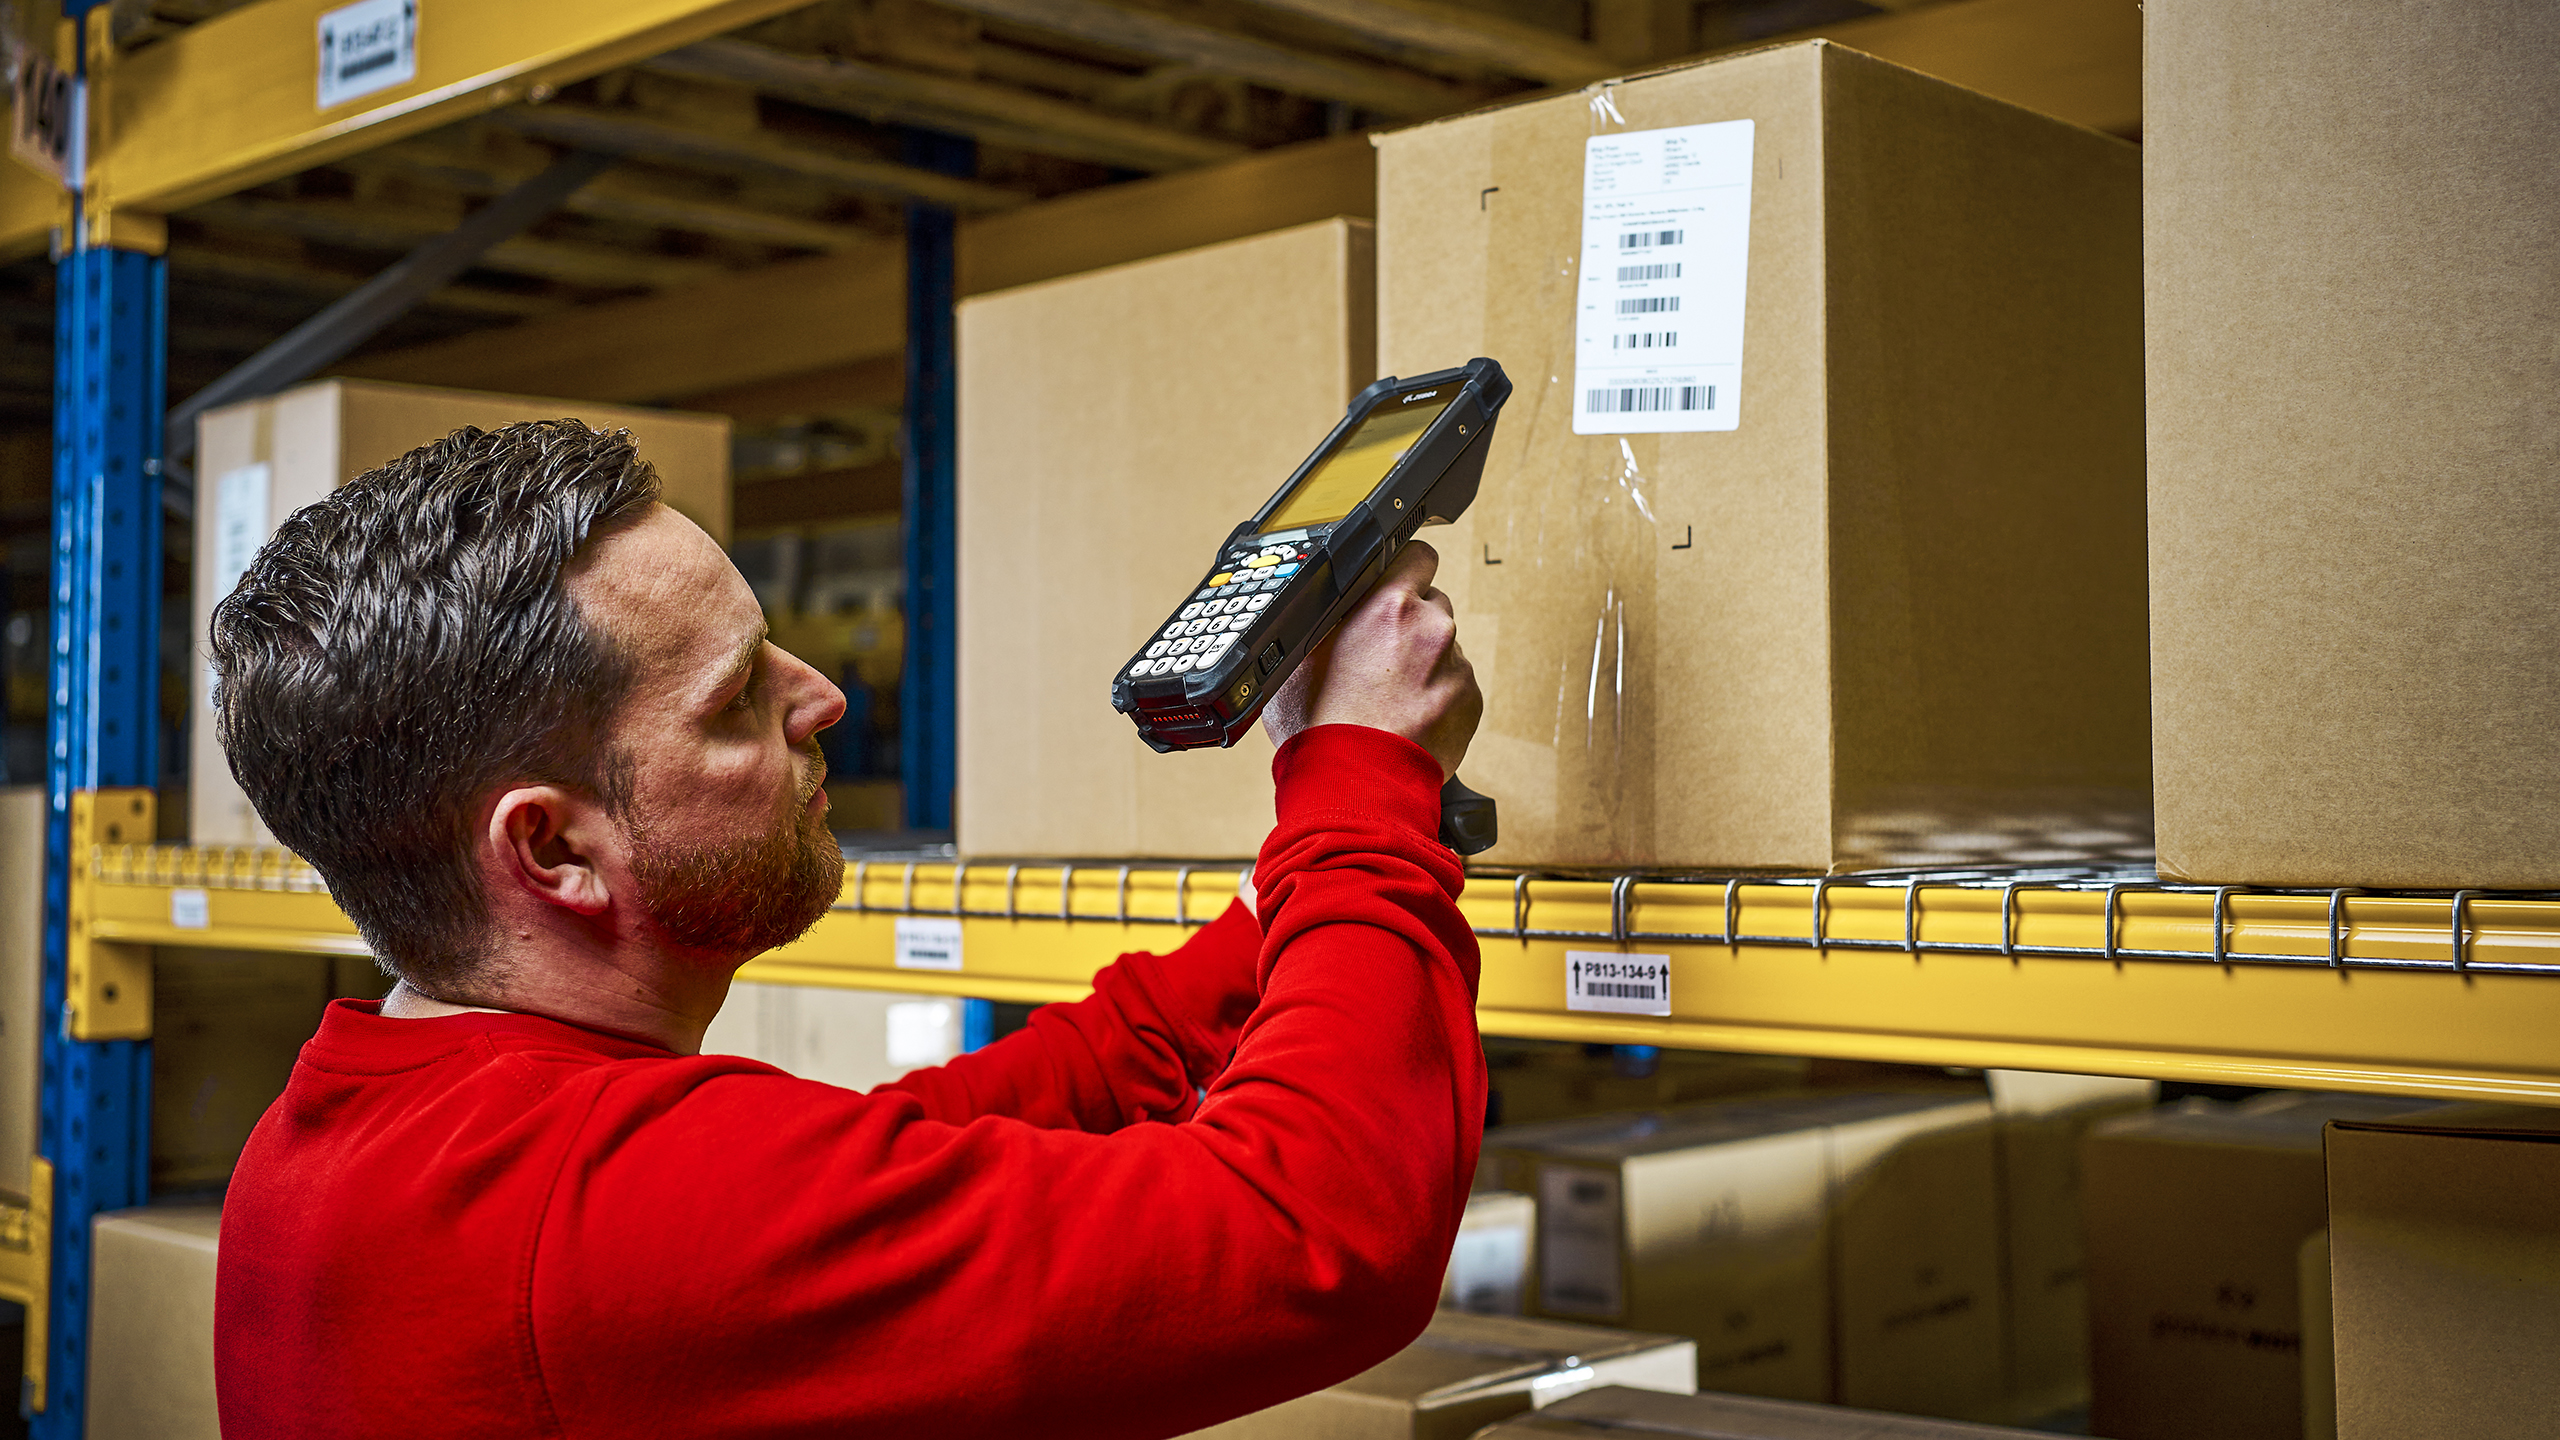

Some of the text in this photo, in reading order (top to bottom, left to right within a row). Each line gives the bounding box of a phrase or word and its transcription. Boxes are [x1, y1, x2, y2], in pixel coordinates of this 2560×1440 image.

[1185, 607, 1196, 616] 7
[1207, 604, 1217, 613] 8
[1229, 601, 1239, 610] 9
[1169, 626, 1179, 635] 4
[1190, 624, 1200, 632] 5
[1212, 621, 1222, 629] 6
[1153, 645, 1162, 654] 1
[1173, 643, 1183, 652] 2
[1195, 640, 1205, 649] 3
[1156, 662, 1166, 670] 0
[1585, 962, 1656, 980] P813-134-9
